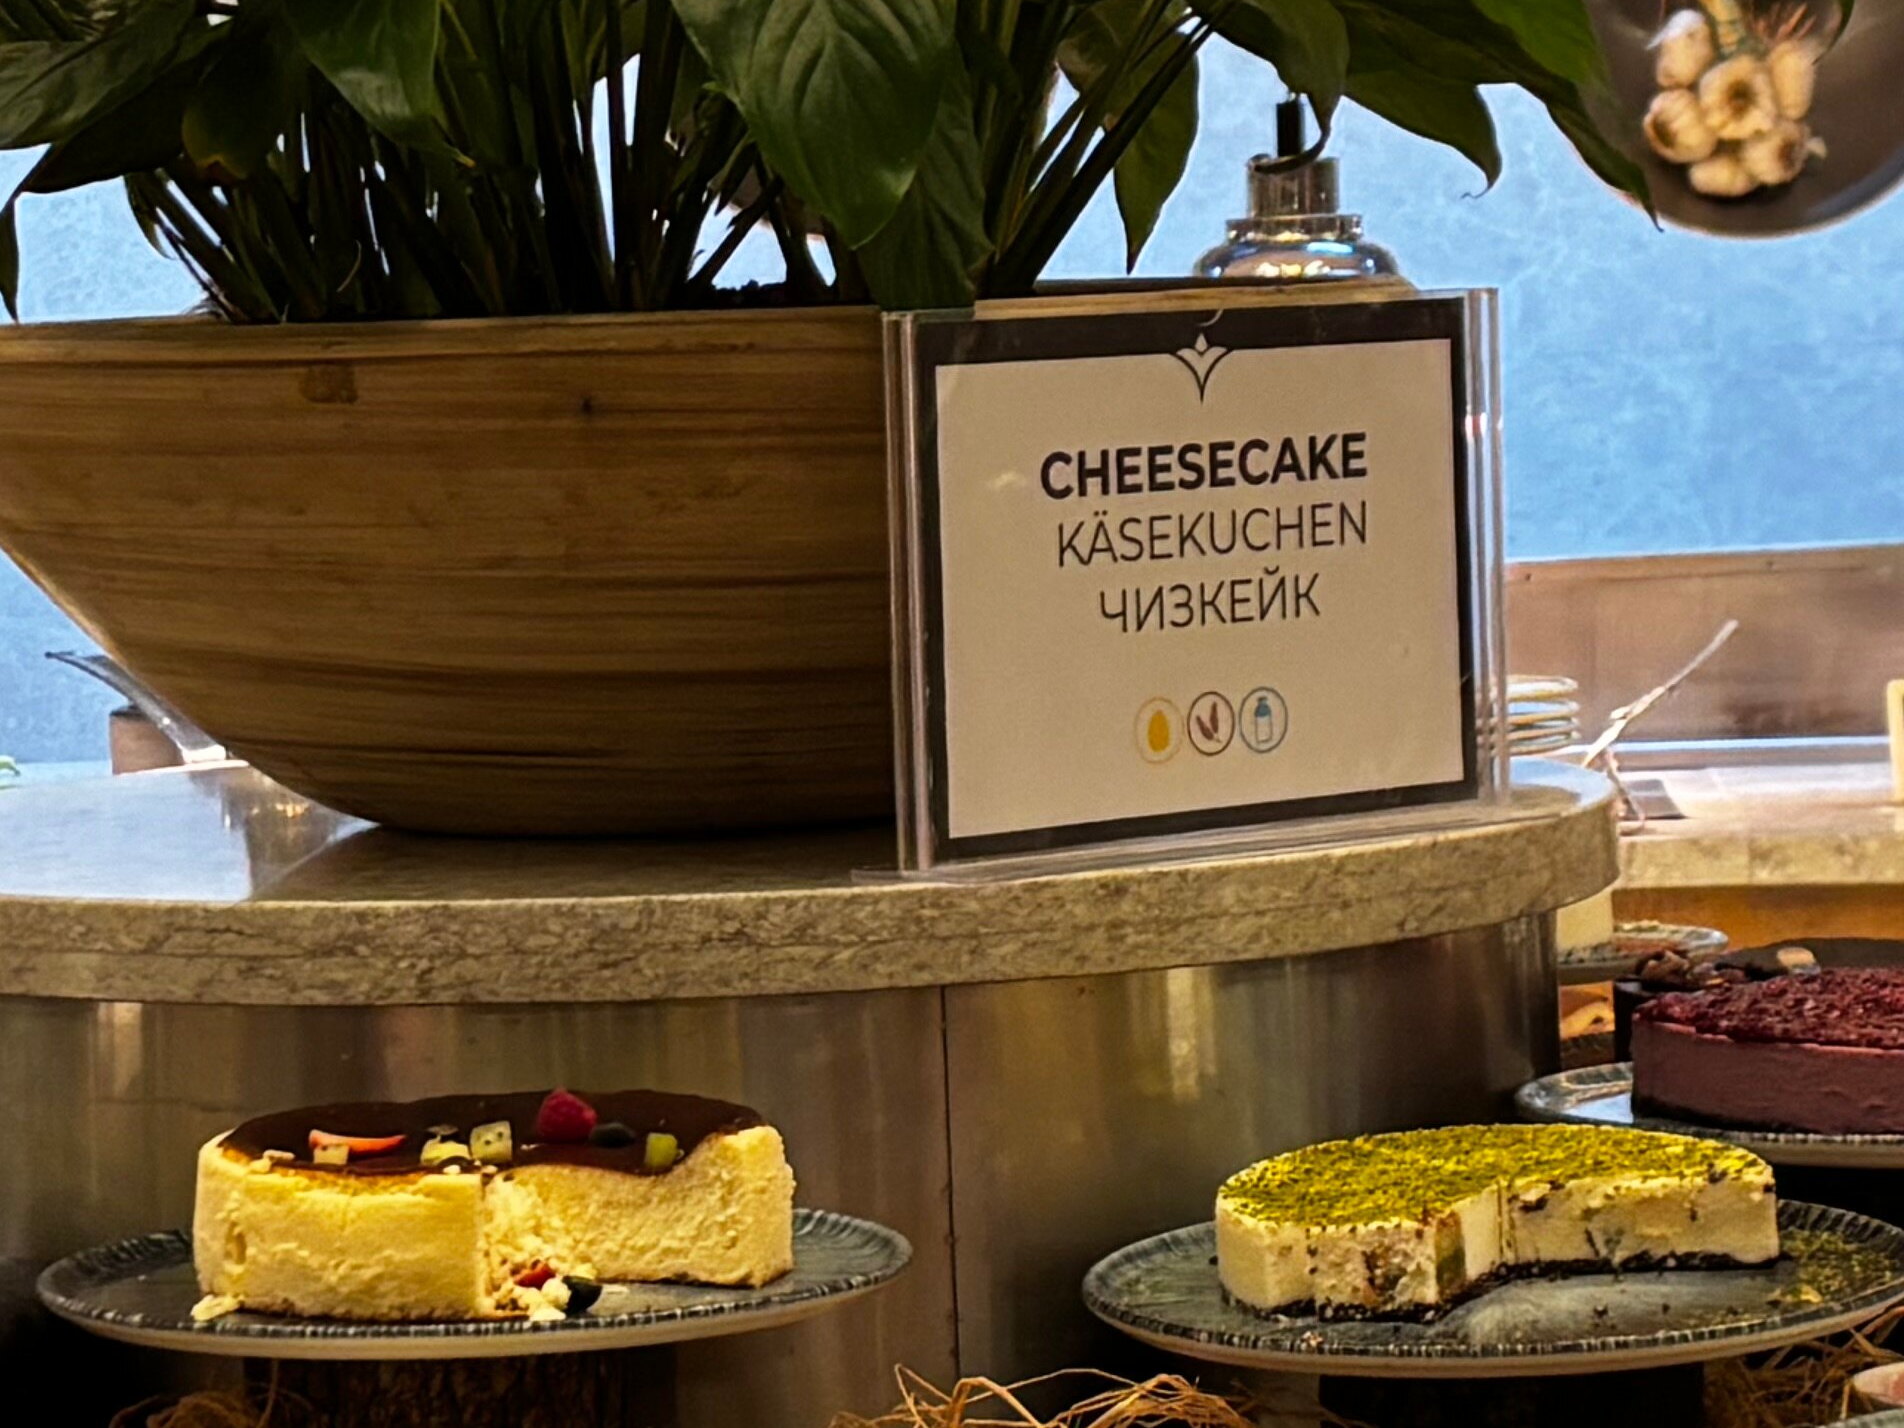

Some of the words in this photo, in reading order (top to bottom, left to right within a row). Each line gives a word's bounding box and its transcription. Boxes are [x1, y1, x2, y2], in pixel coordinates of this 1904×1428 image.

[1039, 432, 1368, 500] CHEESECAKE
[1057, 500, 1367, 567] KÄSEKUCHEN
[1099, 565, 1320, 633] ЧИЗКЕЙК
